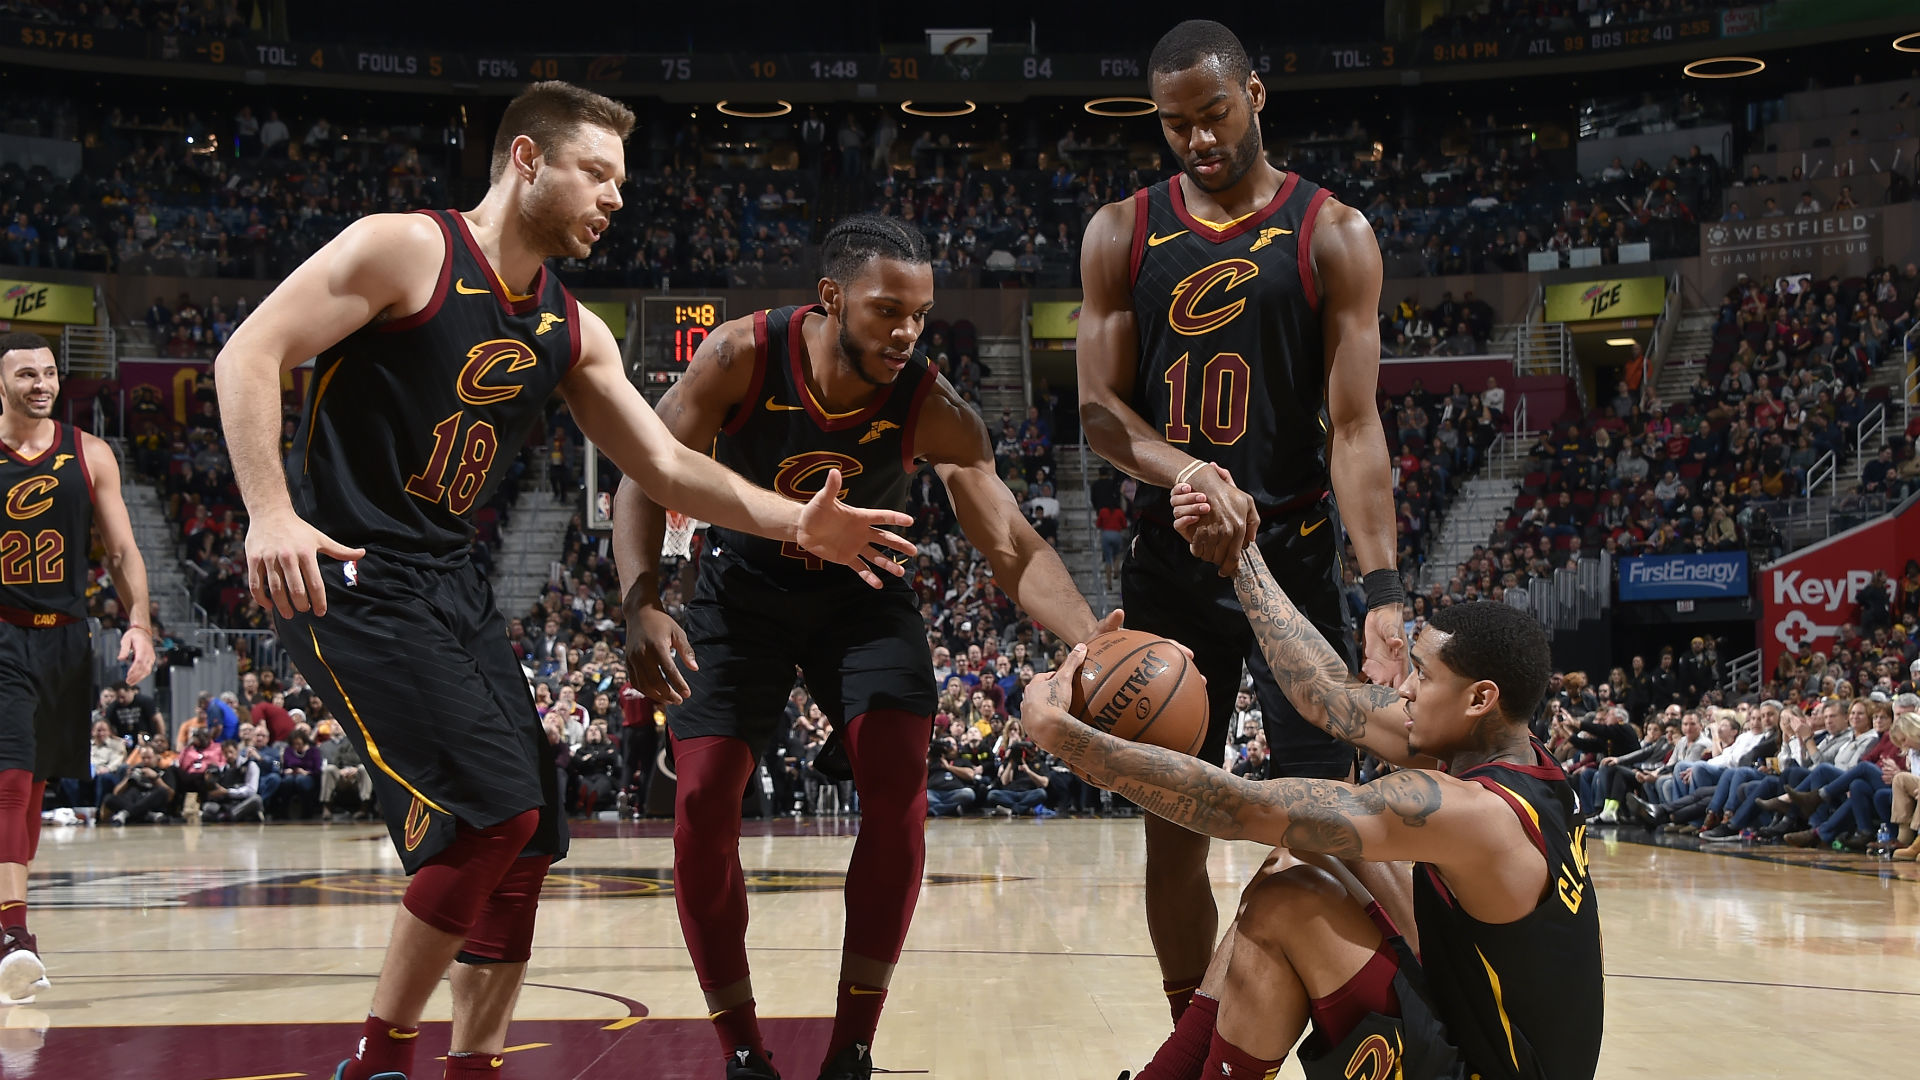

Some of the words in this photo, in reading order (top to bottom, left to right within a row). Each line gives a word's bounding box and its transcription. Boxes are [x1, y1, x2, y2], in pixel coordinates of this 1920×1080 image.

[21, 27, 94, 50] $3,715
[256, 45, 298, 67] TOL:
[310, 48, 325, 69] 4
[357, 52, 418, 75] FOULS
[429, 56, 443, 77] 5
[477, 59, 519, 79] FG%
[530, 59, 559, 78] 40
[661, 58, 691, 80] 75
[749, 61, 777, 79] 10
[810, 61, 858, 79] 1:48
[1023, 57, 1054, 79] 84
[1100, 58, 1140, 78] FG%
[1284, 52, 1297, 73] 2
[1332, 50, 1371, 69] TOL:
[1381, 46, 1395, 67] 3
[1433, 44, 1469, 61] 9:14
[1473, 41, 1499, 59] PM
[1528, 38, 1555, 56] ATL
[1564, 35, 1585, 52] 99
[1591, 31, 1622, 49] BOS
[1625, 28, 1650, 45] 122
[1734, 214, 1867, 241] WESTFIELD
[1710, 246, 1813, 266] CHAMPIONS
[1823, 241, 1868, 257] CLUB
[14, 287, 48, 318] ICE
[1168, 258, 1260, 336] C
[1590, 283, 1622, 318] ICE
[675, 304, 715, 327] 1:48
[456, 338, 537, 405] C
[1164, 351, 1250, 446] 10
[404, 410, 498, 515] 18
[6, 474, 60, 520] C
[0, 529, 64, 584] 22
[1628, 559, 1740, 583] FirstEnergy
[33, 612, 57, 626] CAVS
